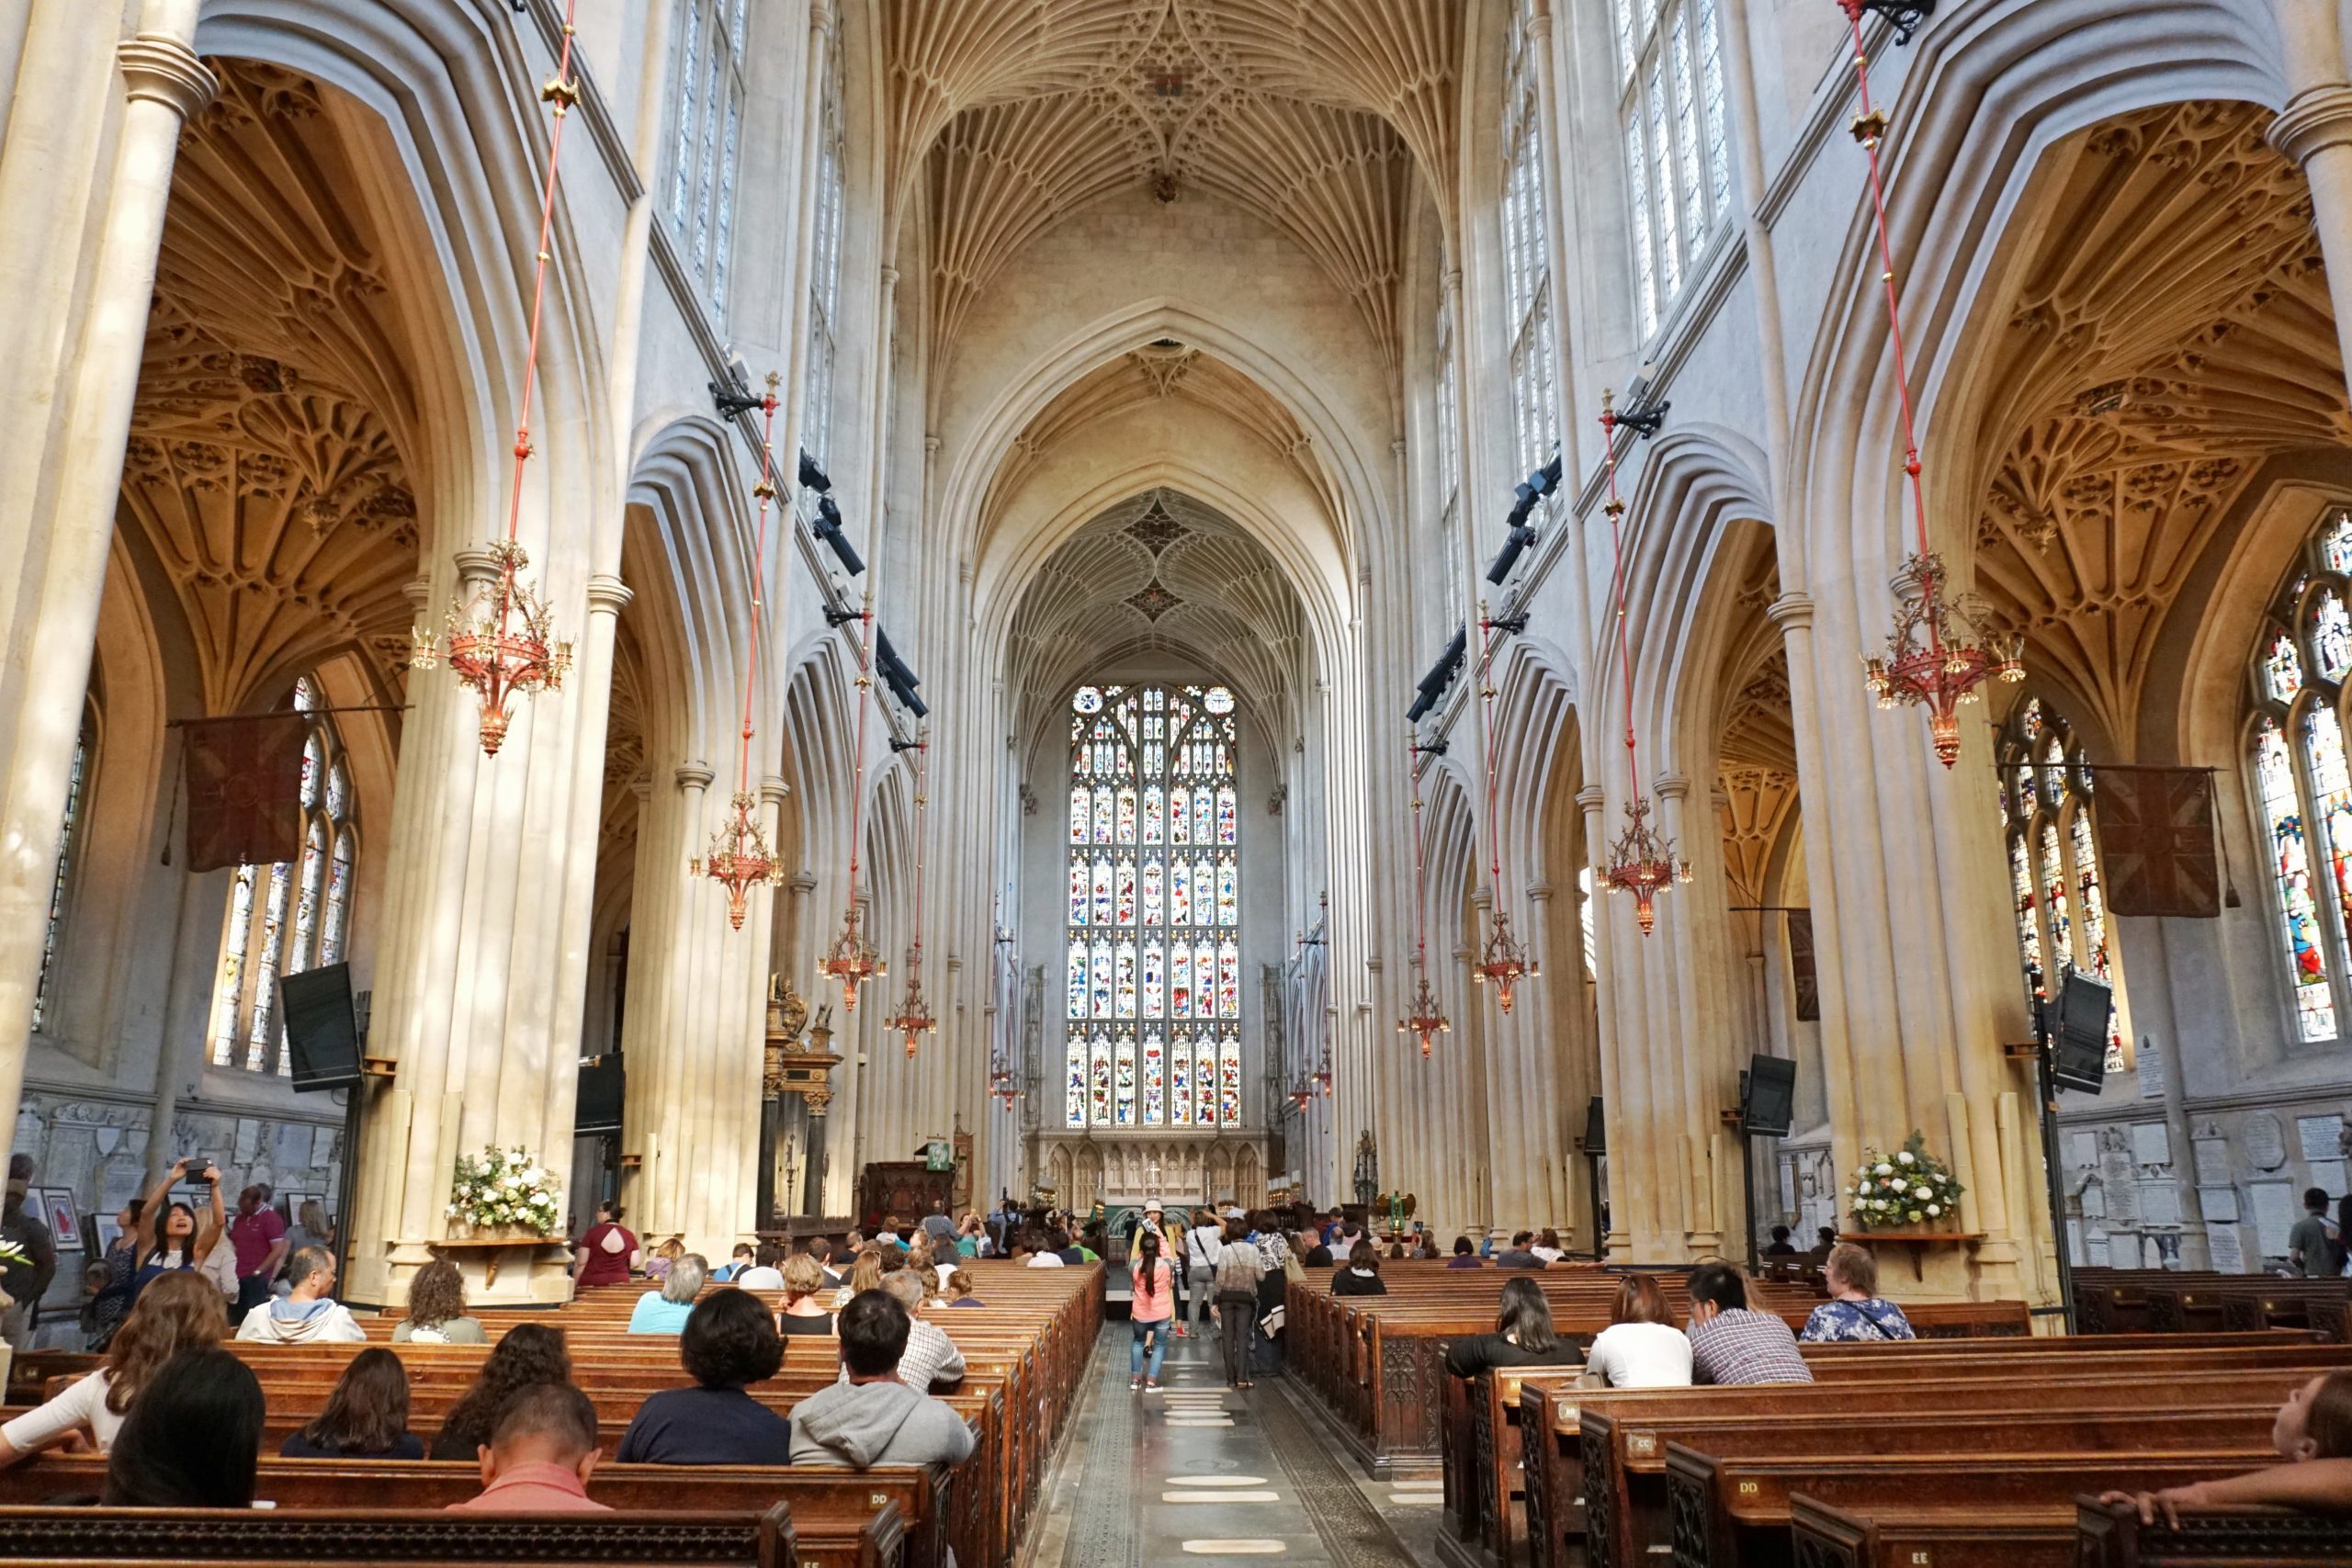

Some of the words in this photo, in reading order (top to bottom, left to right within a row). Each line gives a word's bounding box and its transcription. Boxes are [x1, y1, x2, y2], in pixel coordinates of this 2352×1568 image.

[1638, 1439, 1650, 1449] CC
[1739, 1483, 1758, 1493] DD
[872, 1494, 888, 1505] DD
[1912, 1552, 1928, 1564] EE
